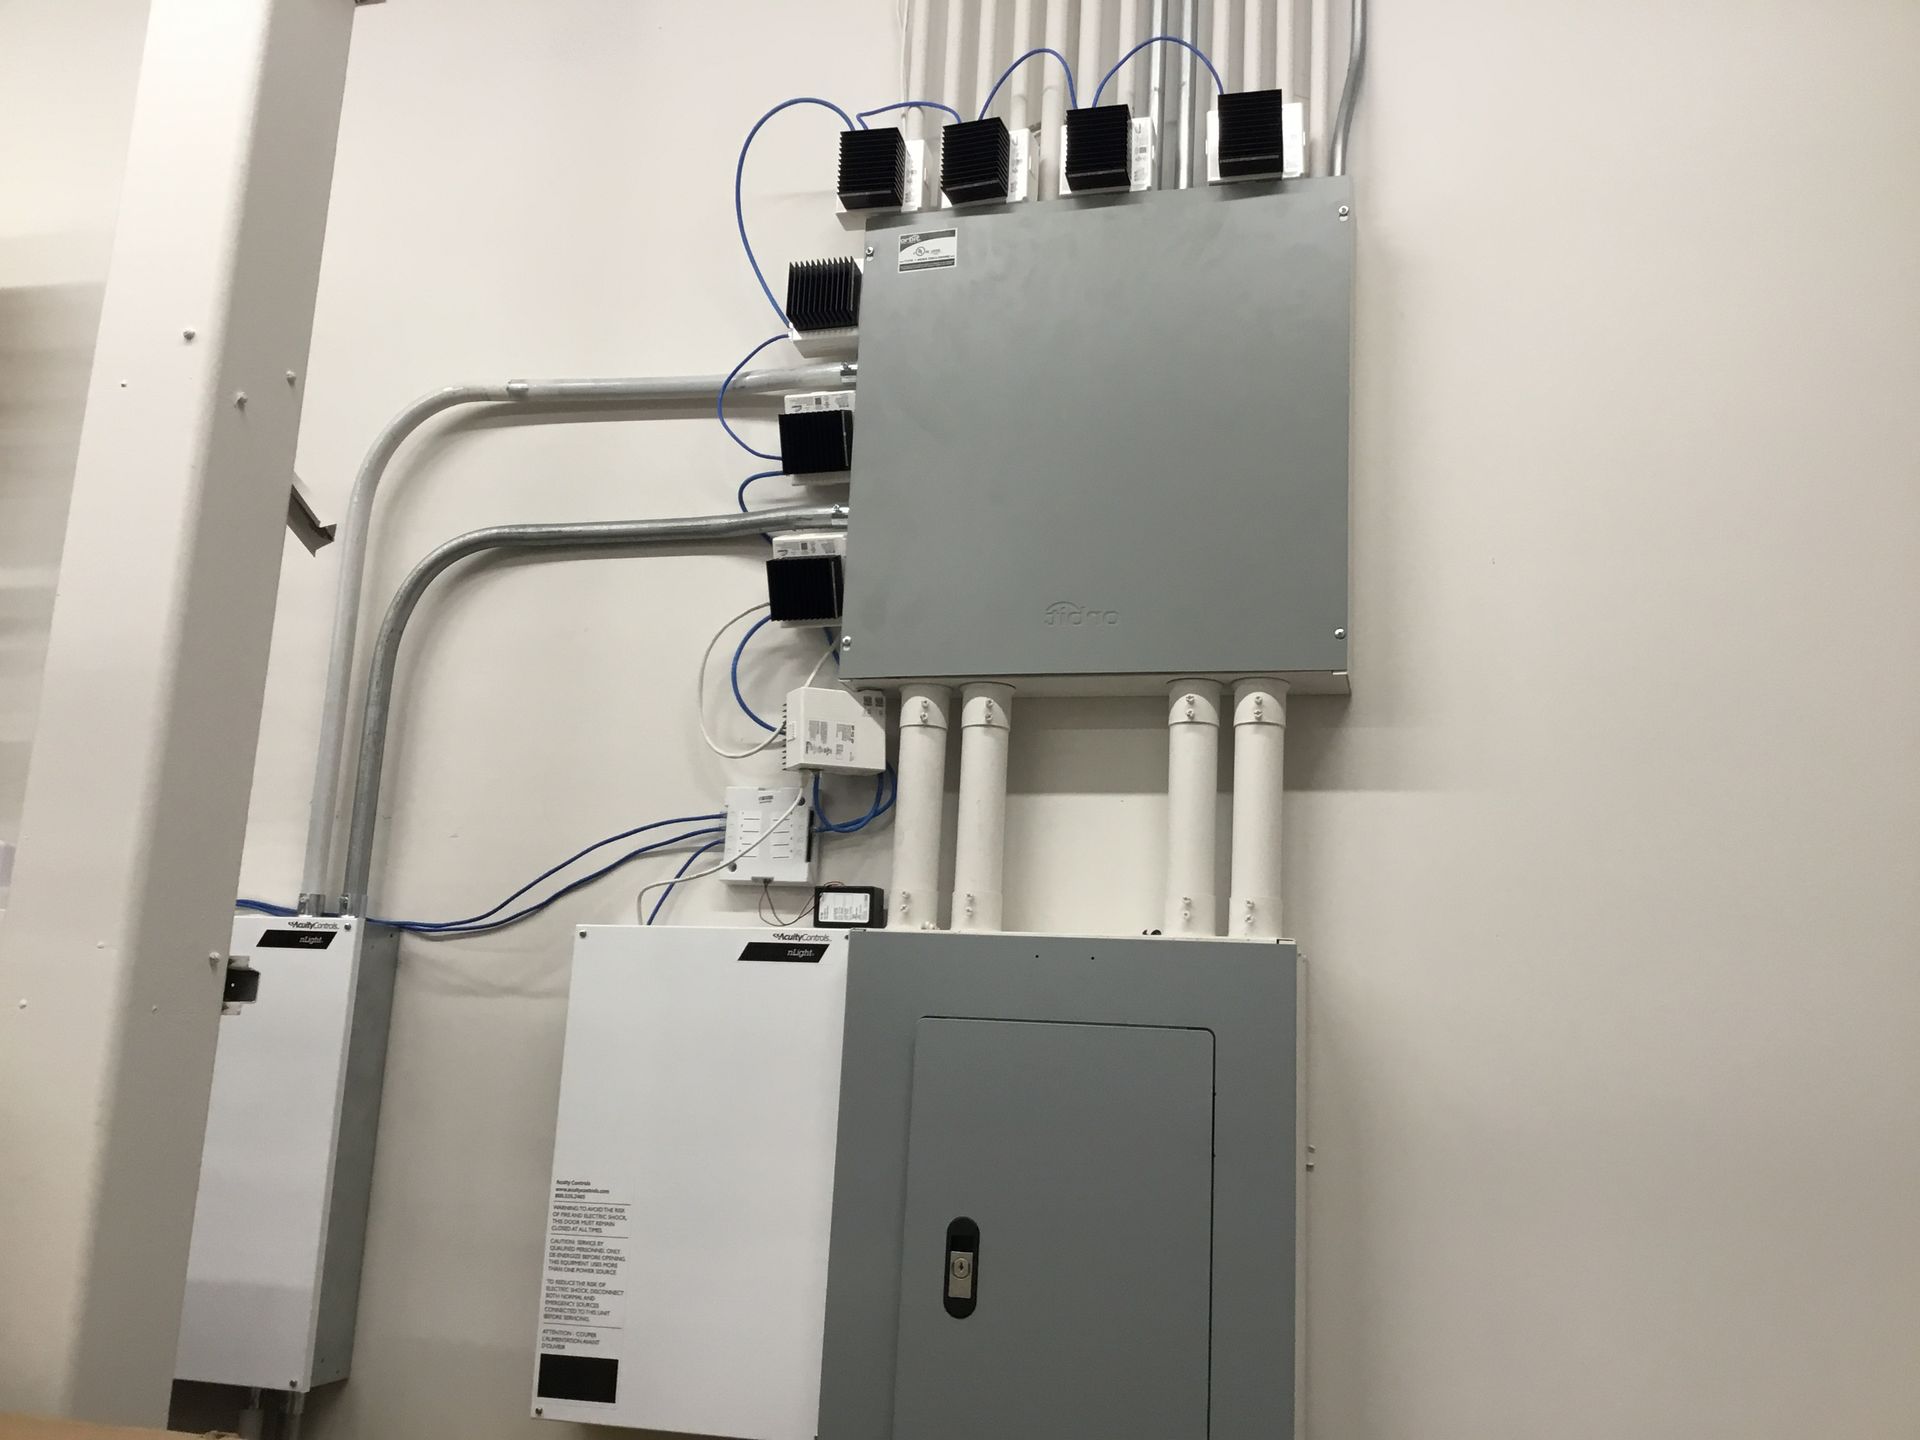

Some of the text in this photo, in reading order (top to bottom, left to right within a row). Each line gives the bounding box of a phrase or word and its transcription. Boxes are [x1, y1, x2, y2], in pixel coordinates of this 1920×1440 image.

[293, 921, 338, 930] AcuityControls
[299, 936, 322, 944] nLight
[779, 933, 830, 942] AcuityControls
[787, 949, 812, 958] nLight
